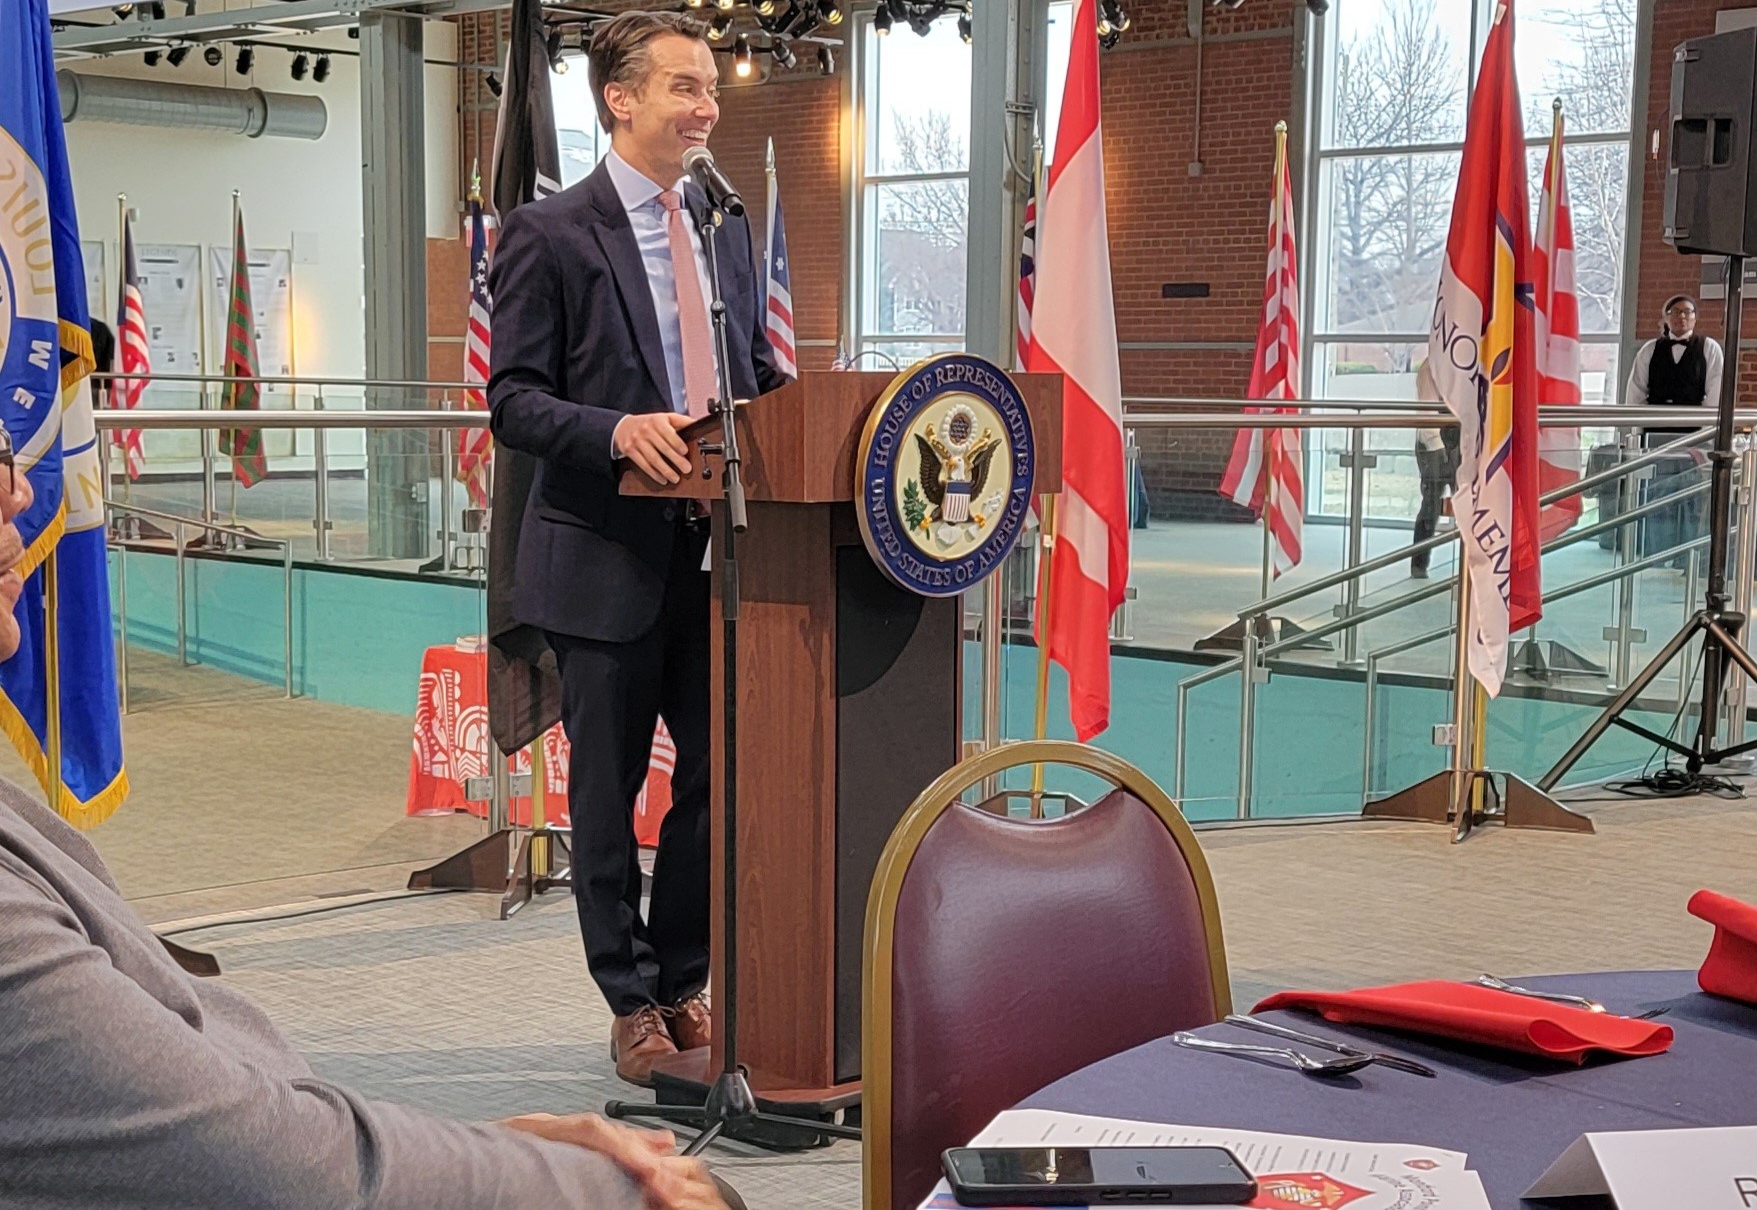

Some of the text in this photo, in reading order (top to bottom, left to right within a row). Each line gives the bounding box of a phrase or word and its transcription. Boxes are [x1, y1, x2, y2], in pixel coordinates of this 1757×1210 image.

[874, 364, 1028, 477] HOUSE OF REPRESENTATIVES
[871, 477, 1027, 587] UNITED STATES OF AMERICA
